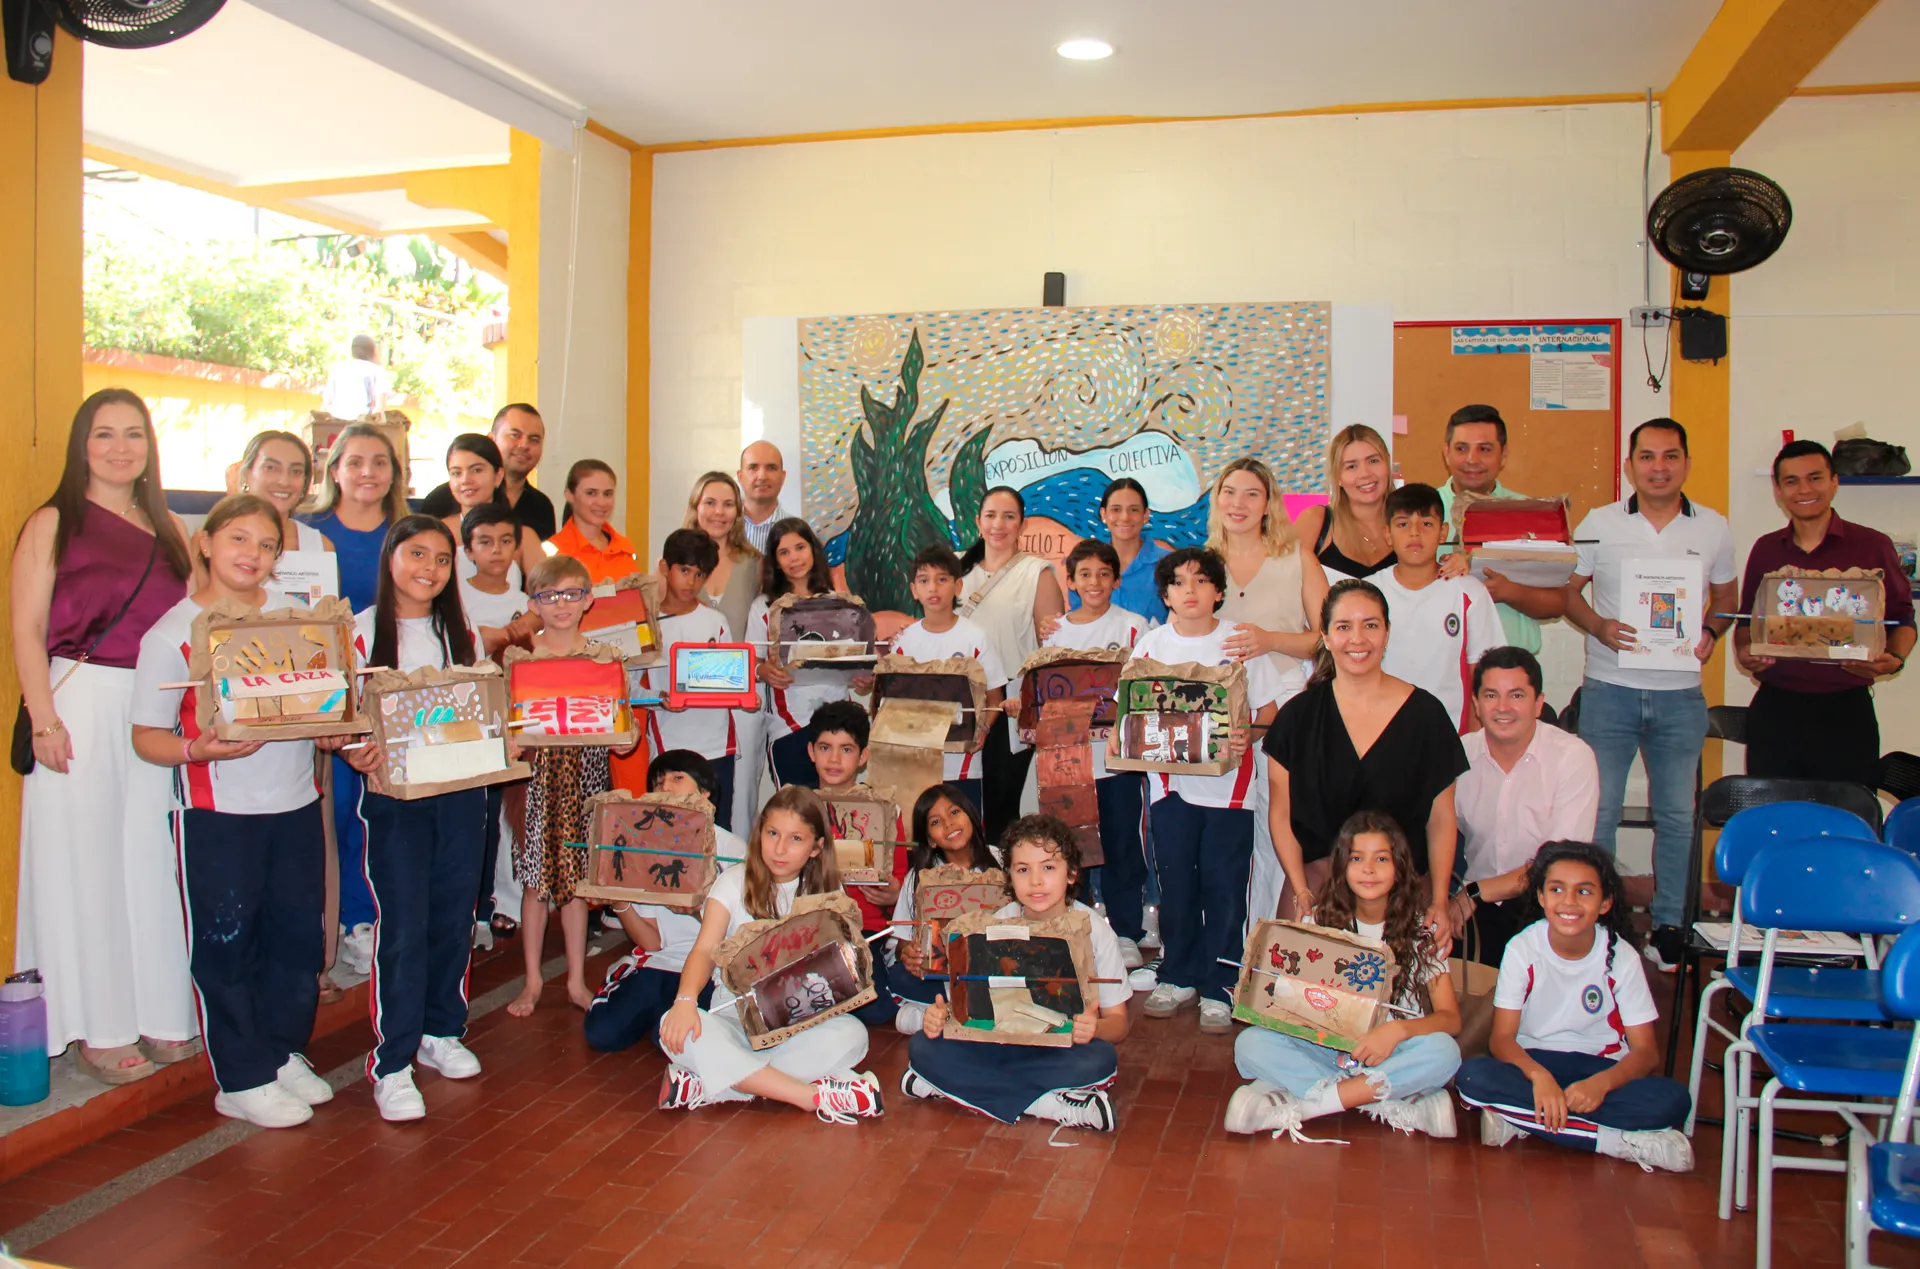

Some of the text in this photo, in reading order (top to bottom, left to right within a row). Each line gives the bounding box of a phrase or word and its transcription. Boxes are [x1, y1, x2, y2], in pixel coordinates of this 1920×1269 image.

[1539, 335, 1602, 343] INTERNACIONAL
[1109, 443, 1182, 474] COLECTIVA
[241, 671, 334, 687] LA CAZA
